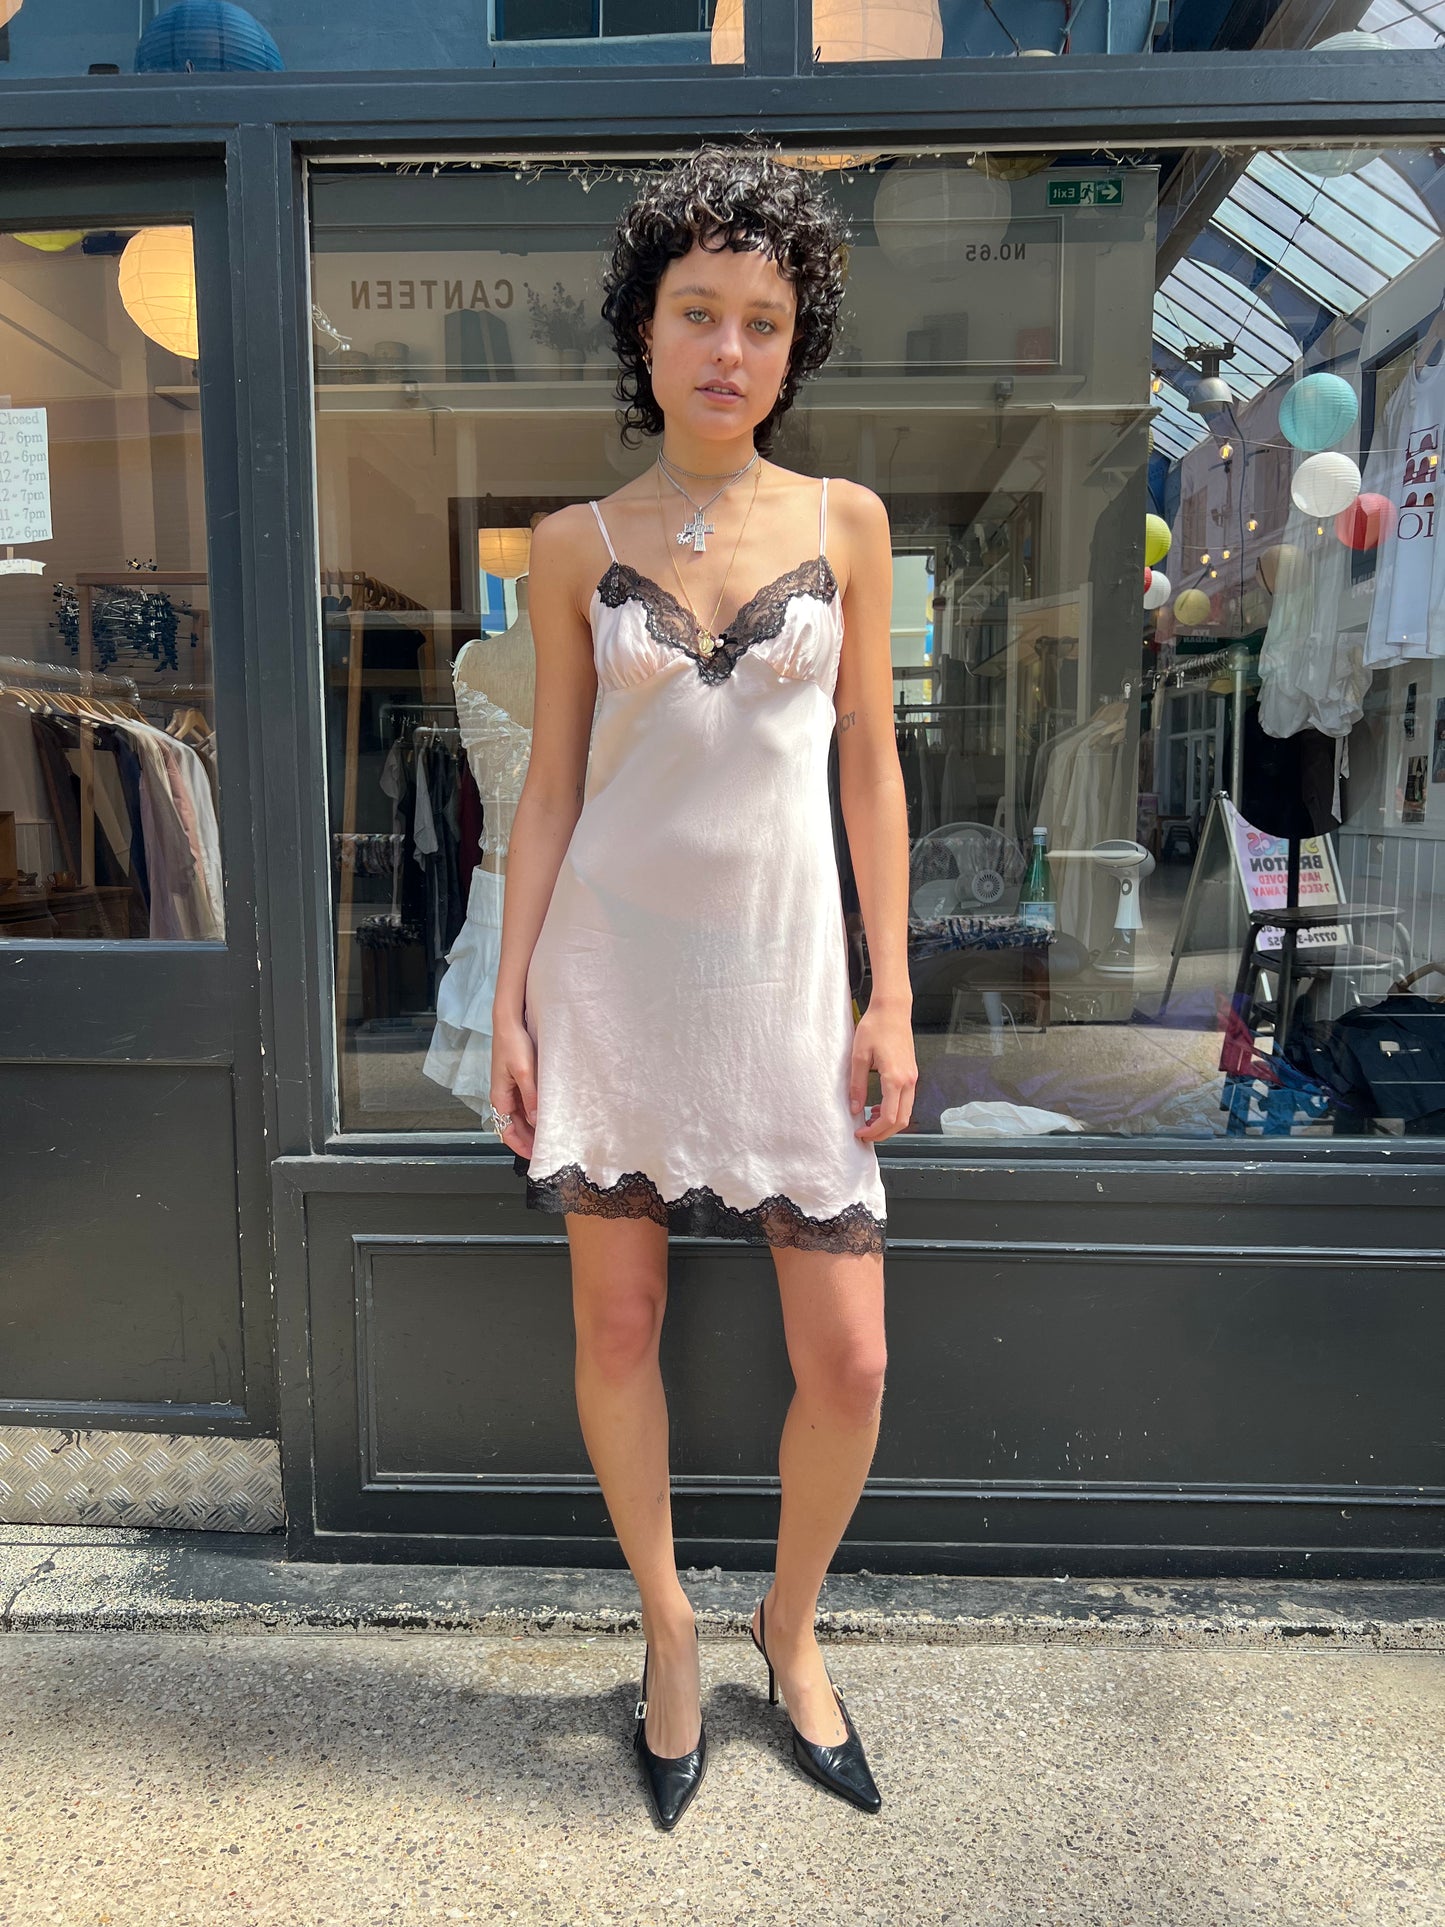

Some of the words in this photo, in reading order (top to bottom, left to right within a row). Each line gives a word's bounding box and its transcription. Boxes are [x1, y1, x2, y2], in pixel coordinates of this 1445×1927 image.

[0, 411, 39, 425] Closed
[16, 431, 43, 447] 6pm
[21, 450, 47, 466] 6pm
[22, 468, 47, 485] 7pm
[0, 488, 10, 501] 2
[20, 489, 45, 504] 7pm
[22, 507, 46, 523] 7pm
[0, 526, 14, 540] 12
[24, 526, 48, 541] 6pm
